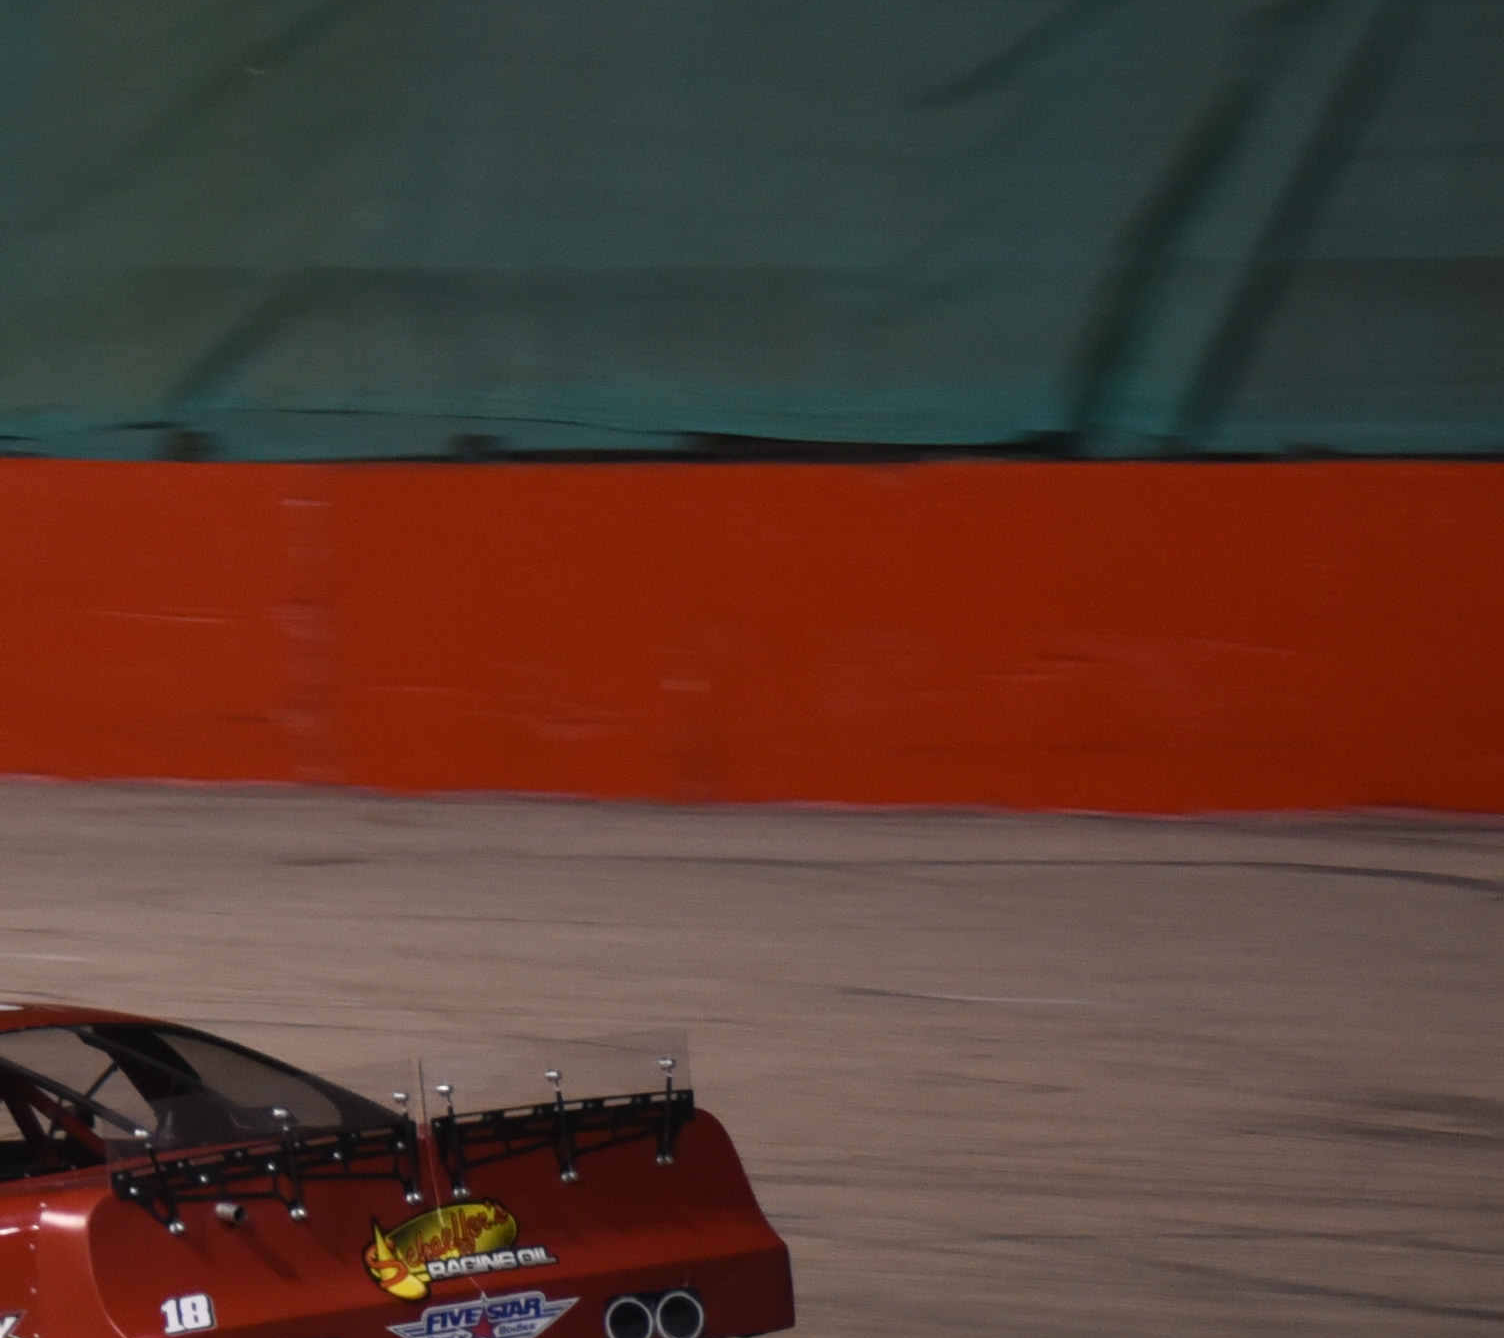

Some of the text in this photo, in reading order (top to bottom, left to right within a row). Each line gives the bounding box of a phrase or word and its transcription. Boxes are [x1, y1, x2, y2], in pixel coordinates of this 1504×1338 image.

[428, 1246, 558, 1280] RACING OIL
[161, 1293, 214, 1335] 18
[426, 1297, 542, 1336] FIVE STAR
